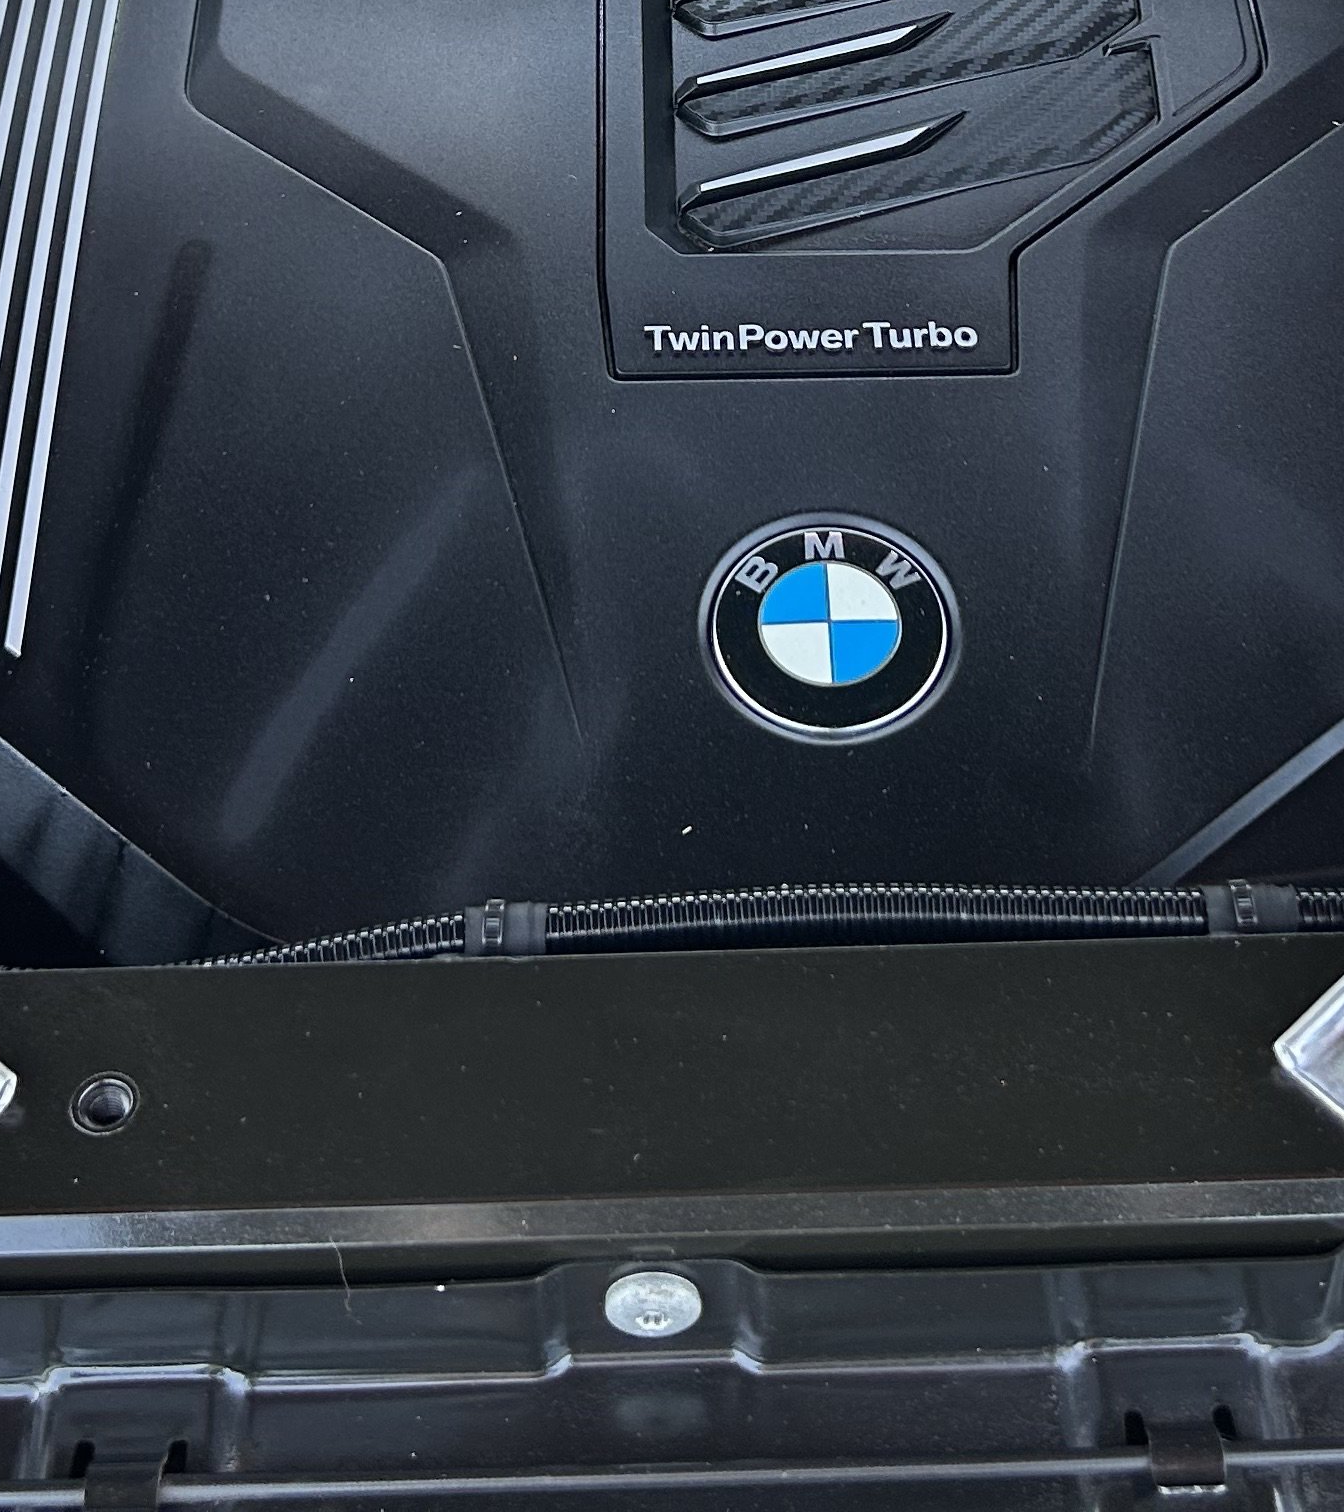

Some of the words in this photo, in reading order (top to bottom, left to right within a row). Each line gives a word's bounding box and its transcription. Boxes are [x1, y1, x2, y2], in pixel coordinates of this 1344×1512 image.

[643, 323, 859, 352] TwinPower
[862, 320, 979, 349] Turbo
[734, 530, 923, 595] BMW
